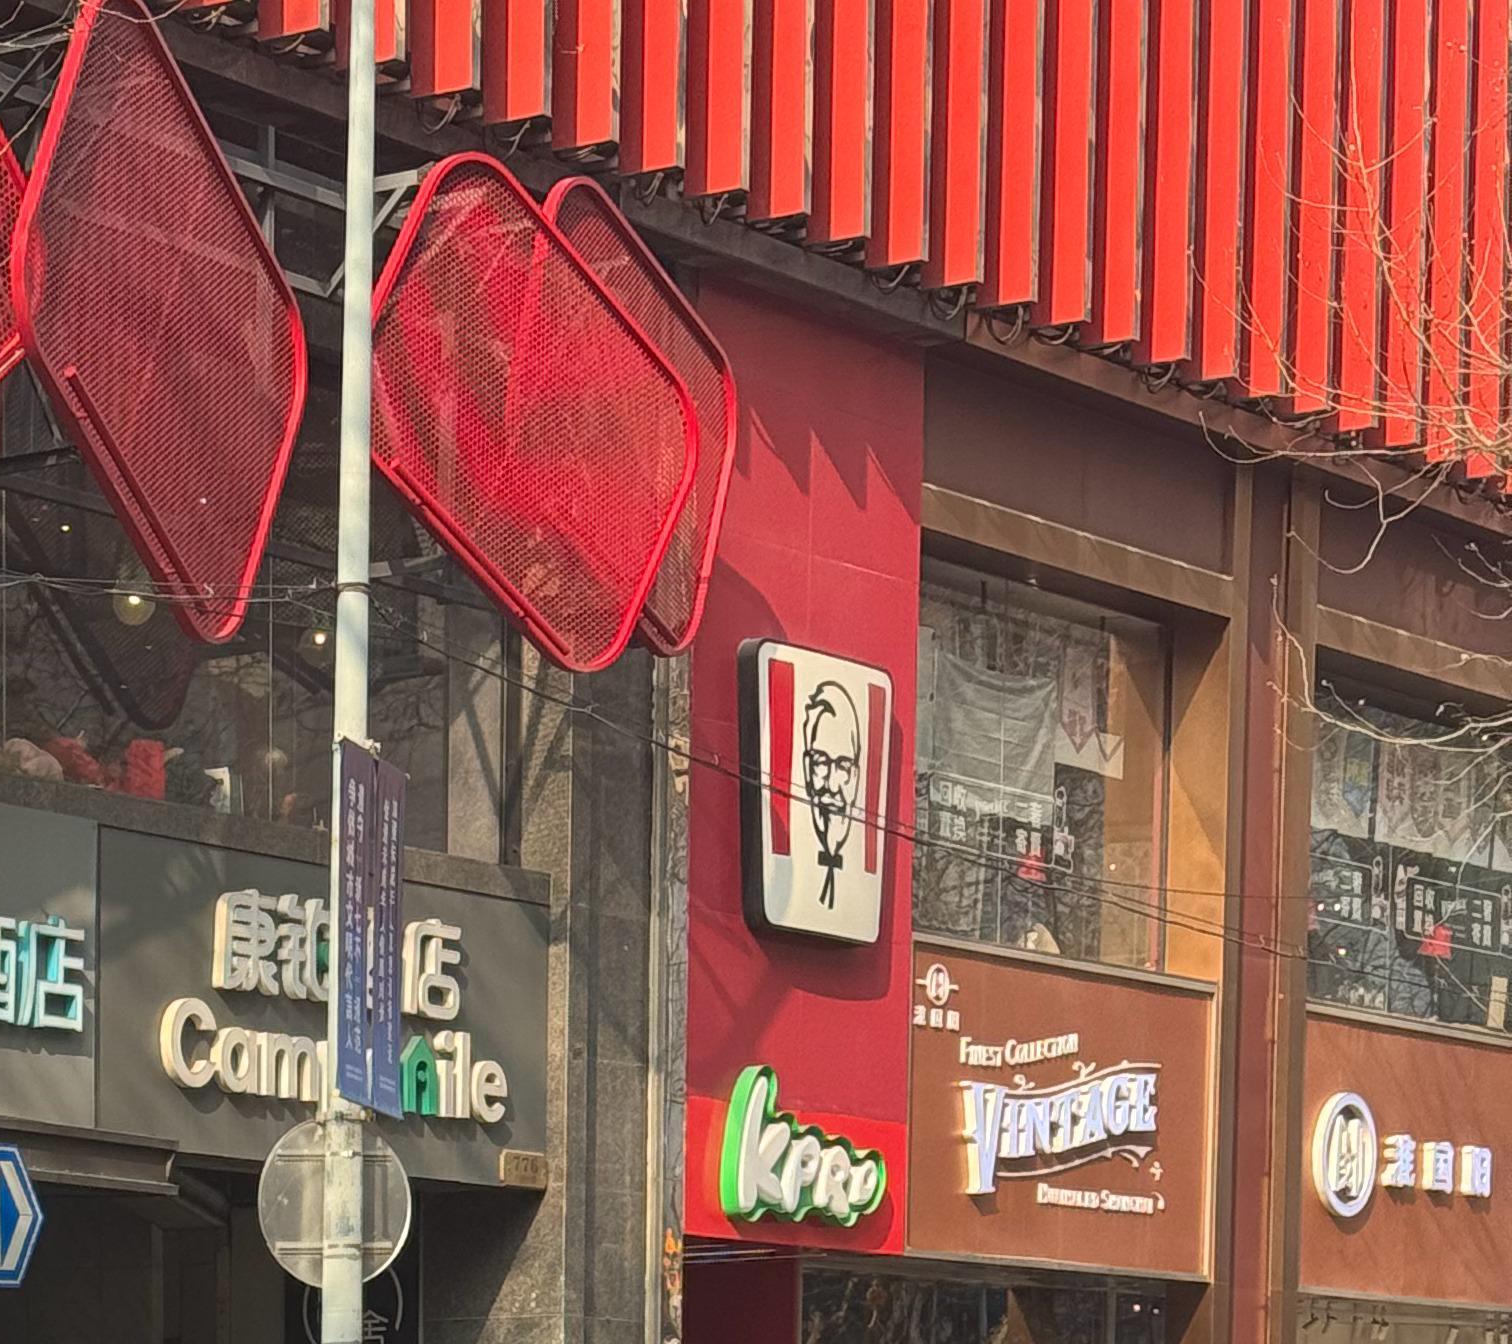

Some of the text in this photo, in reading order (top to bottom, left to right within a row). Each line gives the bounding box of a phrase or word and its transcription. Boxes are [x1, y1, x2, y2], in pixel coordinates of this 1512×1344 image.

[212, 888, 462, 1021] 康铂店
[959, 1073, 1159, 1194] VINTAGE
